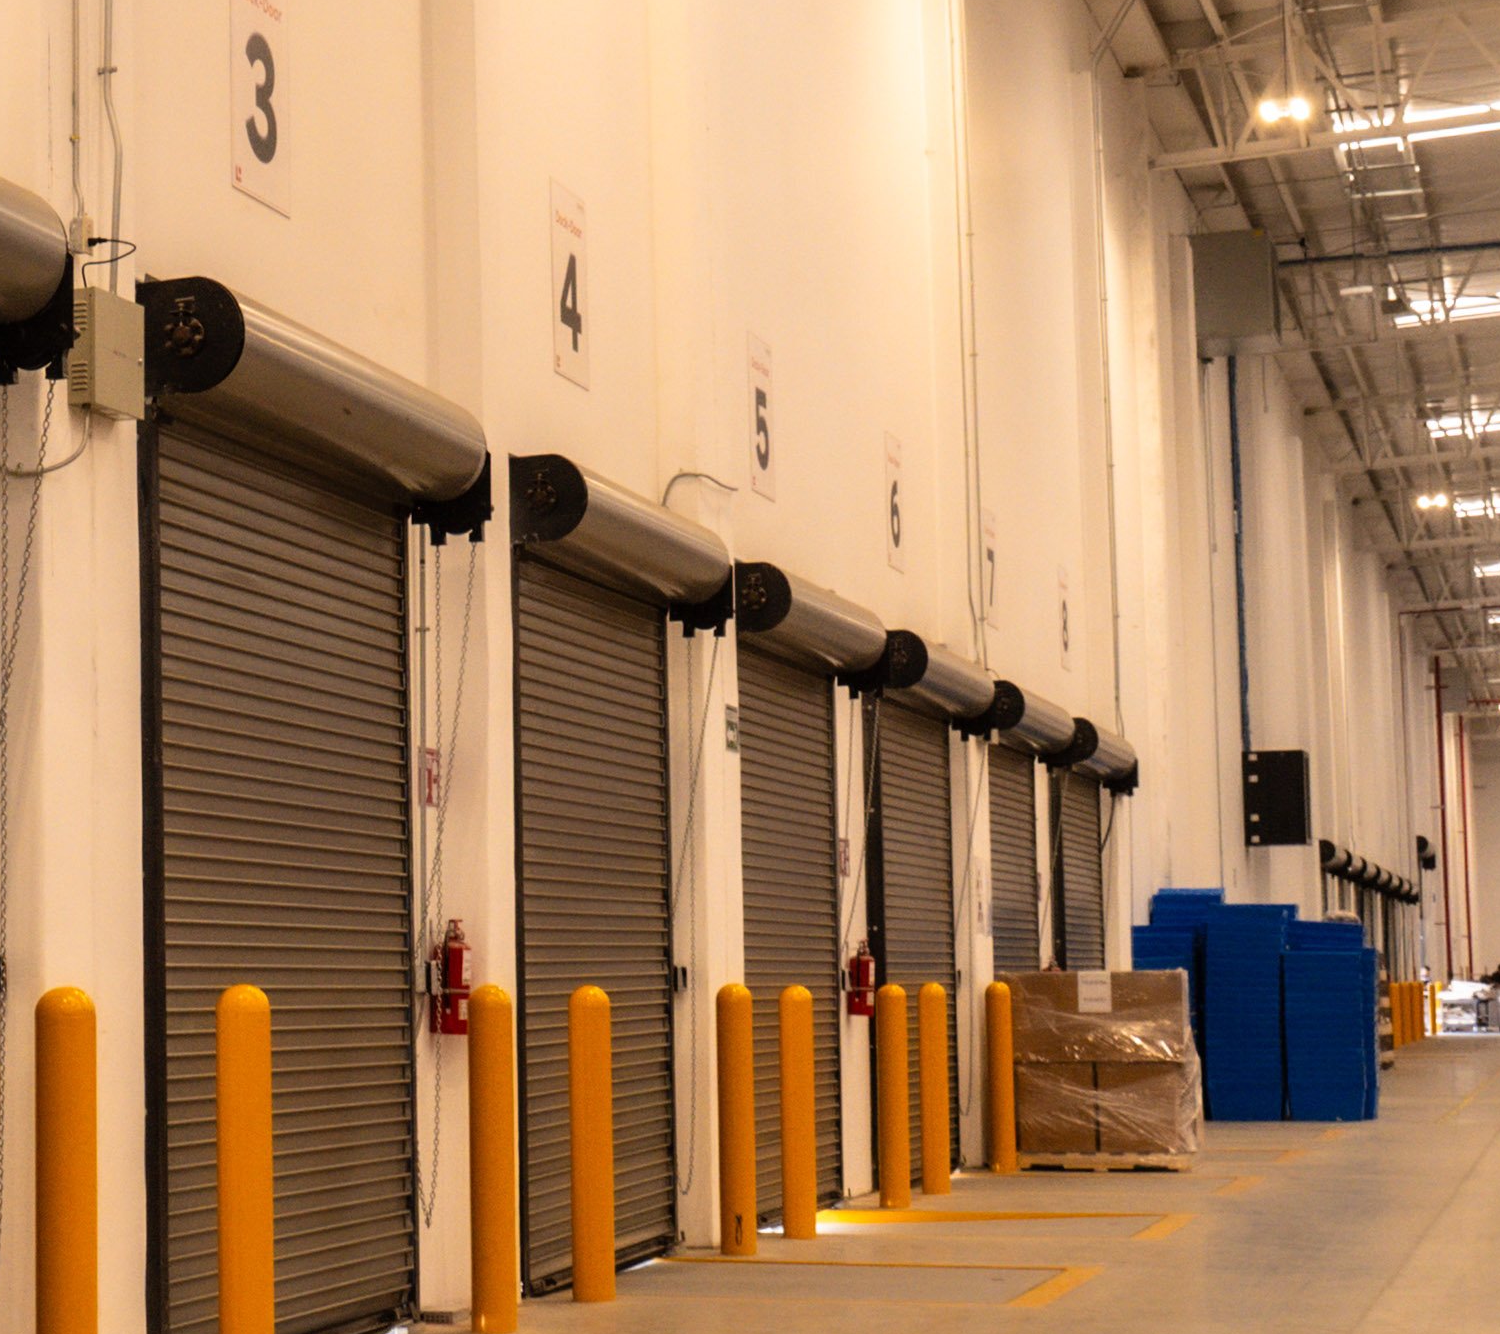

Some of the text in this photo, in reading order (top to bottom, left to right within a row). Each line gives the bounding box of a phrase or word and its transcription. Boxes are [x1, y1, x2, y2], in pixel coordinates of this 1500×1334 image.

[245, 32, 277, 164] 3
[560, 253, 582, 353] 4
[755, 386, 770, 471] 5
[890, 479, 901, 548] 6
[986, 546, 995, 607] 7
